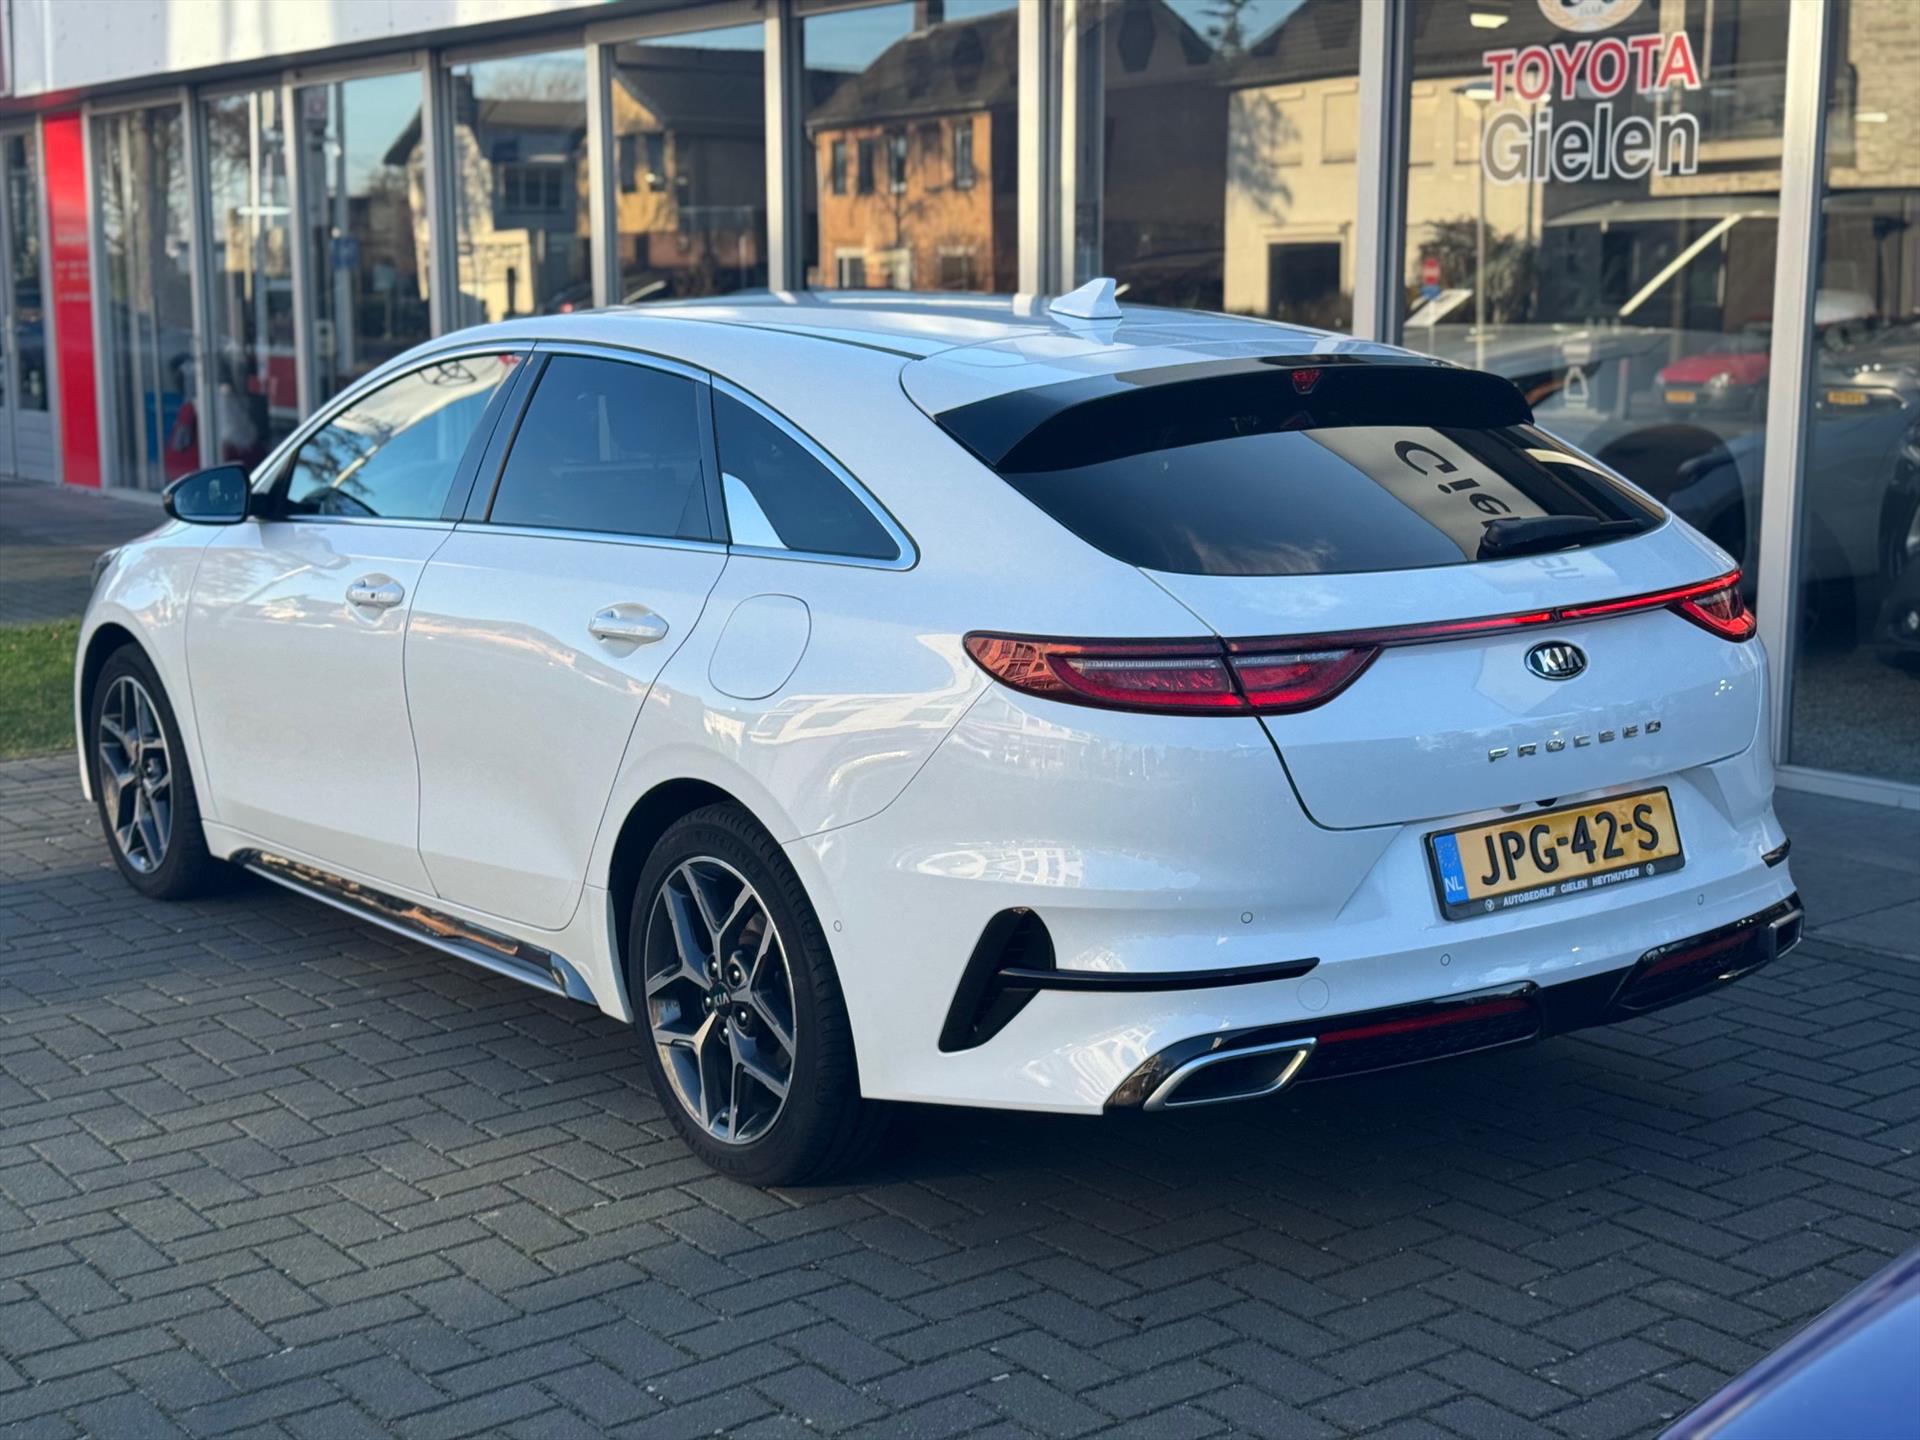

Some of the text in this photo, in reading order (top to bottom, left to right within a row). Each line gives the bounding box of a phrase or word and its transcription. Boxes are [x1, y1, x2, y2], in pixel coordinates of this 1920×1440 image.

[1483, 31, 1701, 103] TOYOTA
[1482, 102, 1700, 184] Gielen
[1534, 646, 1584, 673] KIA
[1488, 720, 1661, 762] PROCEED
[1481, 803, 1660, 886] JPG-42-S
[1445, 876, 1464, 892] NL
[1503, 867, 1640, 907] AUTOBEDRIJF GIELEN HEYTHUYSEN
